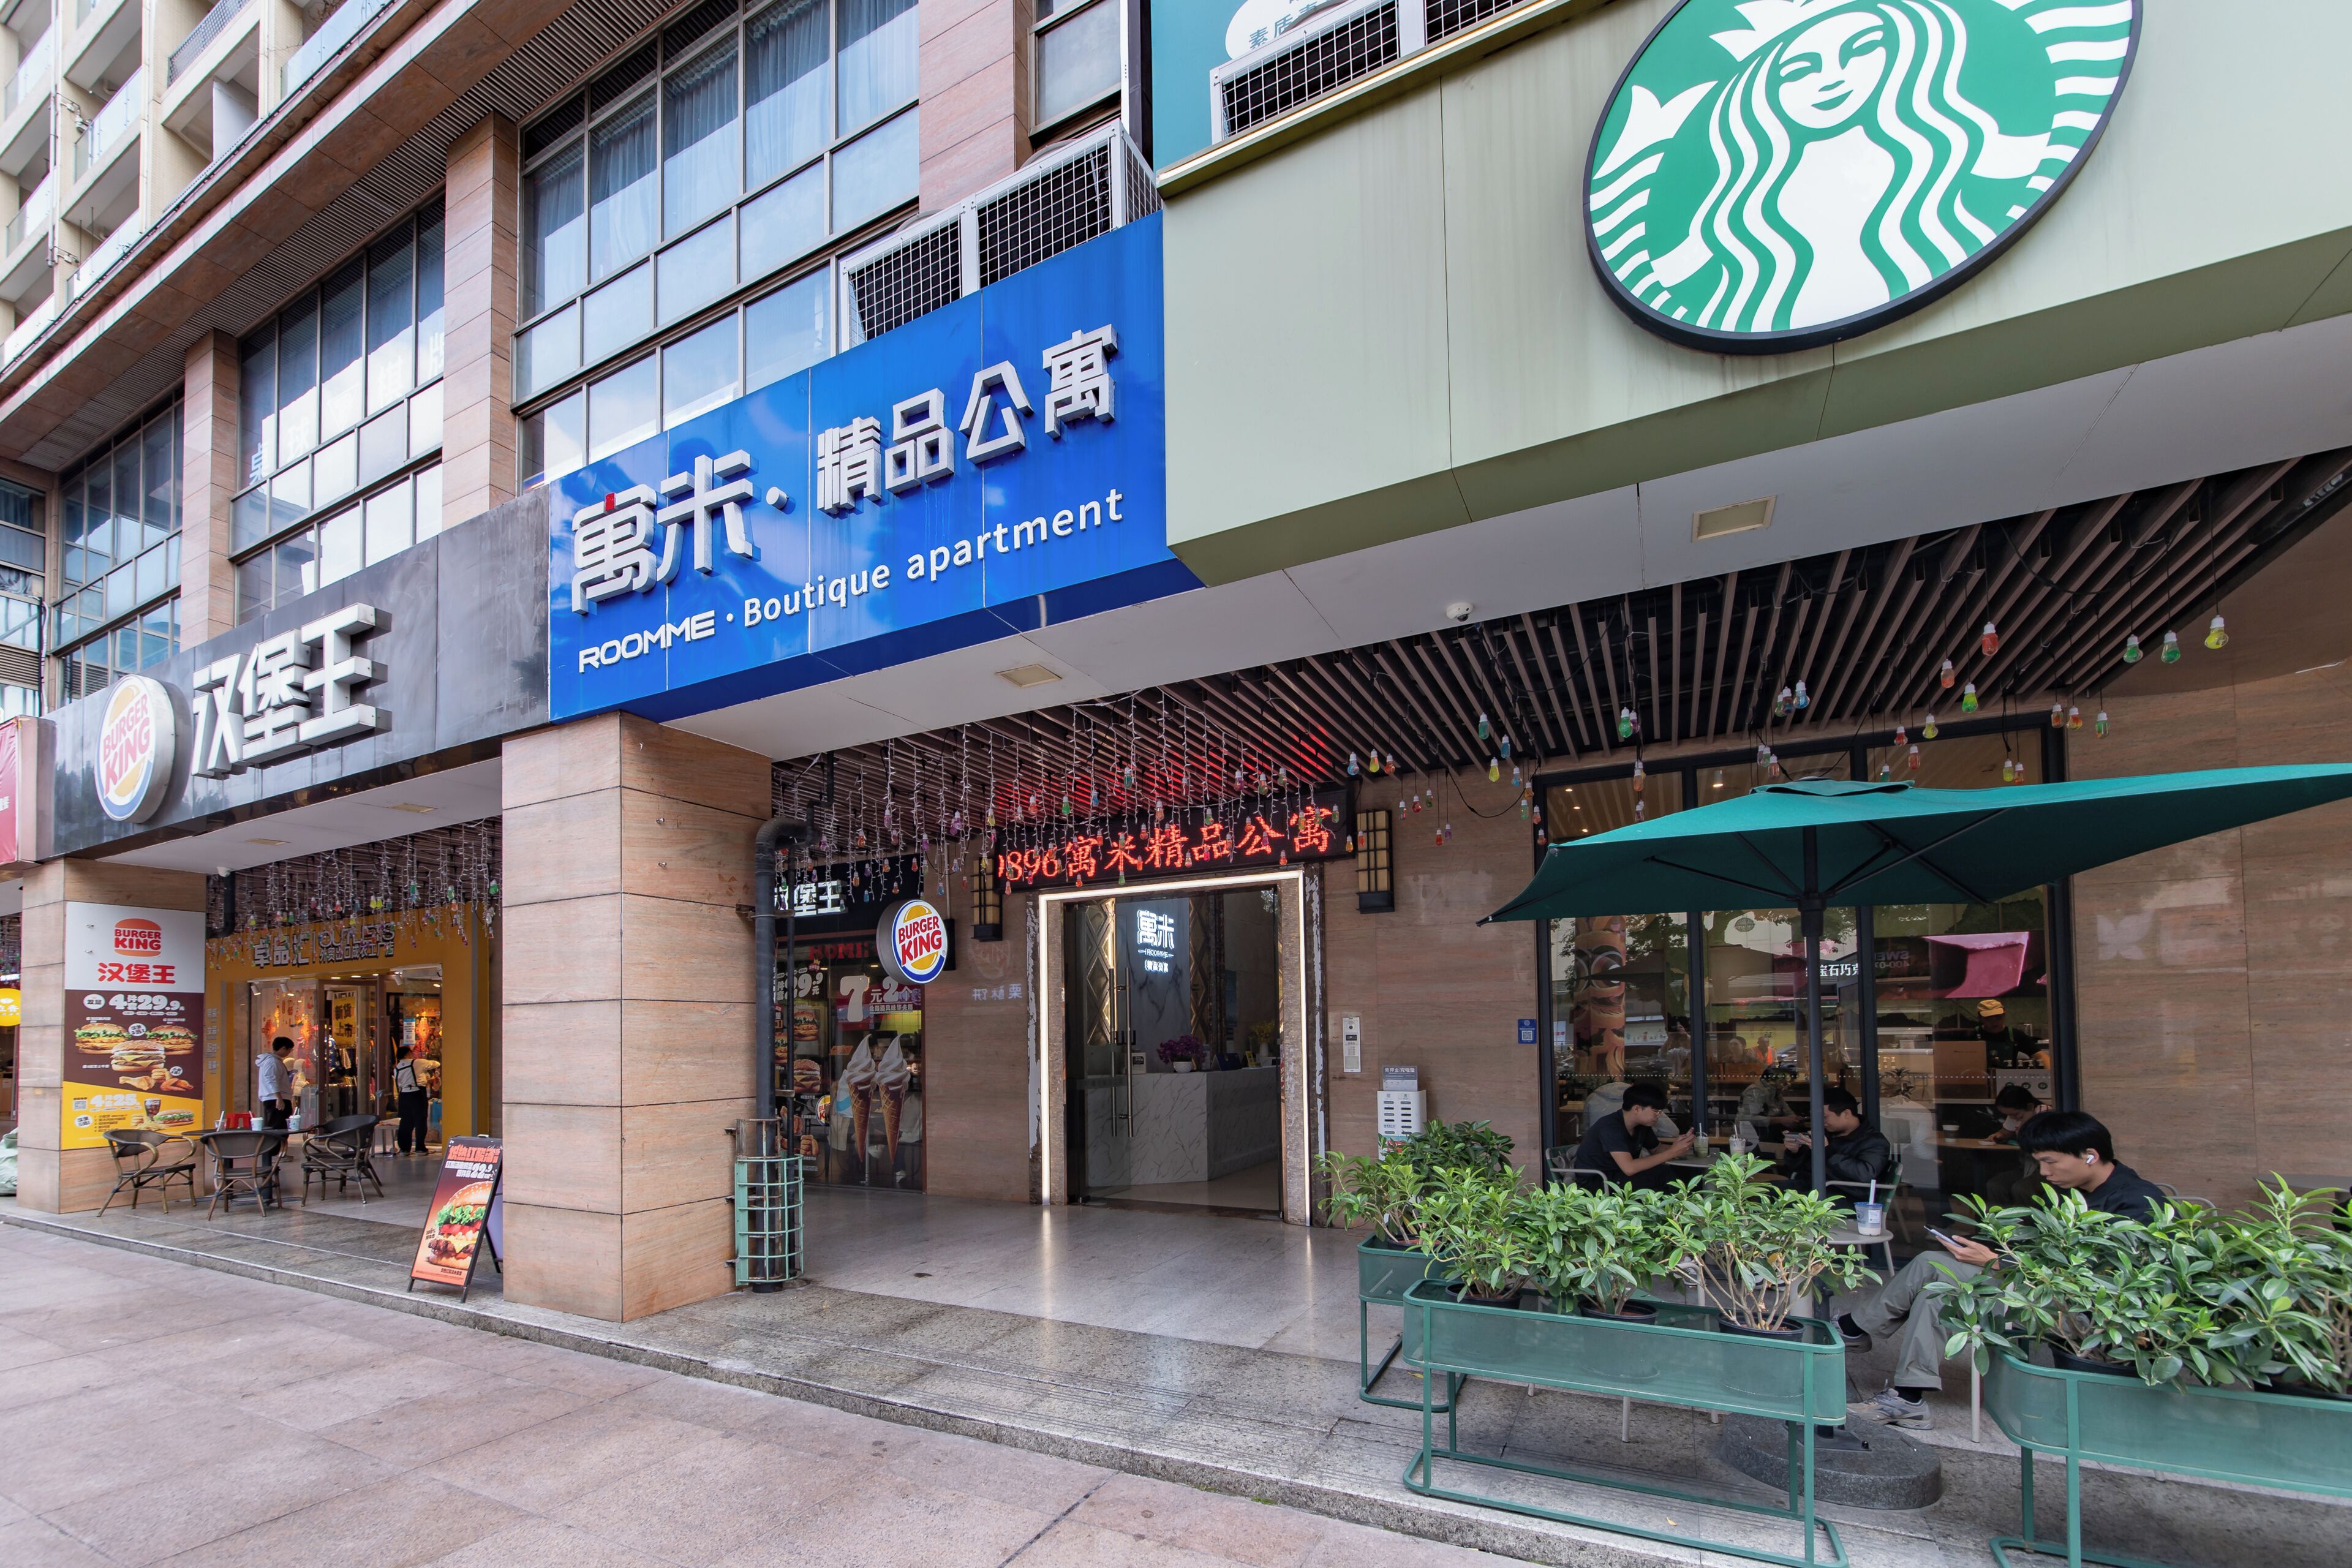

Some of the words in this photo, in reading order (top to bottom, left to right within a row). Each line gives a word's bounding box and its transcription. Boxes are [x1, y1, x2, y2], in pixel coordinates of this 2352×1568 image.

[579, 610, 715, 673] ROOMME
[744, 564, 891, 628] Boutique
[907, 488, 1123, 582] apartment
[191, 602, 376, 778] 汉堡王
[104, 693, 148, 763] BURGER
[104, 716, 151, 796] KING
[115, 929, 162, 940] BURGER
[318, 922, 395, 948] OUTLETS
[898, 916, 940, 944] BURGER
[1137, 910, 1175, 949] 寓米
[115, 937, 162, 951] KING
[901, 929, 942, 966] KING
[1146, 949, 1169, 958] ROOMME
[97, 962, 176, 984] 汉堡王
[1806, 963, 1859, 977] 宝石巧克
